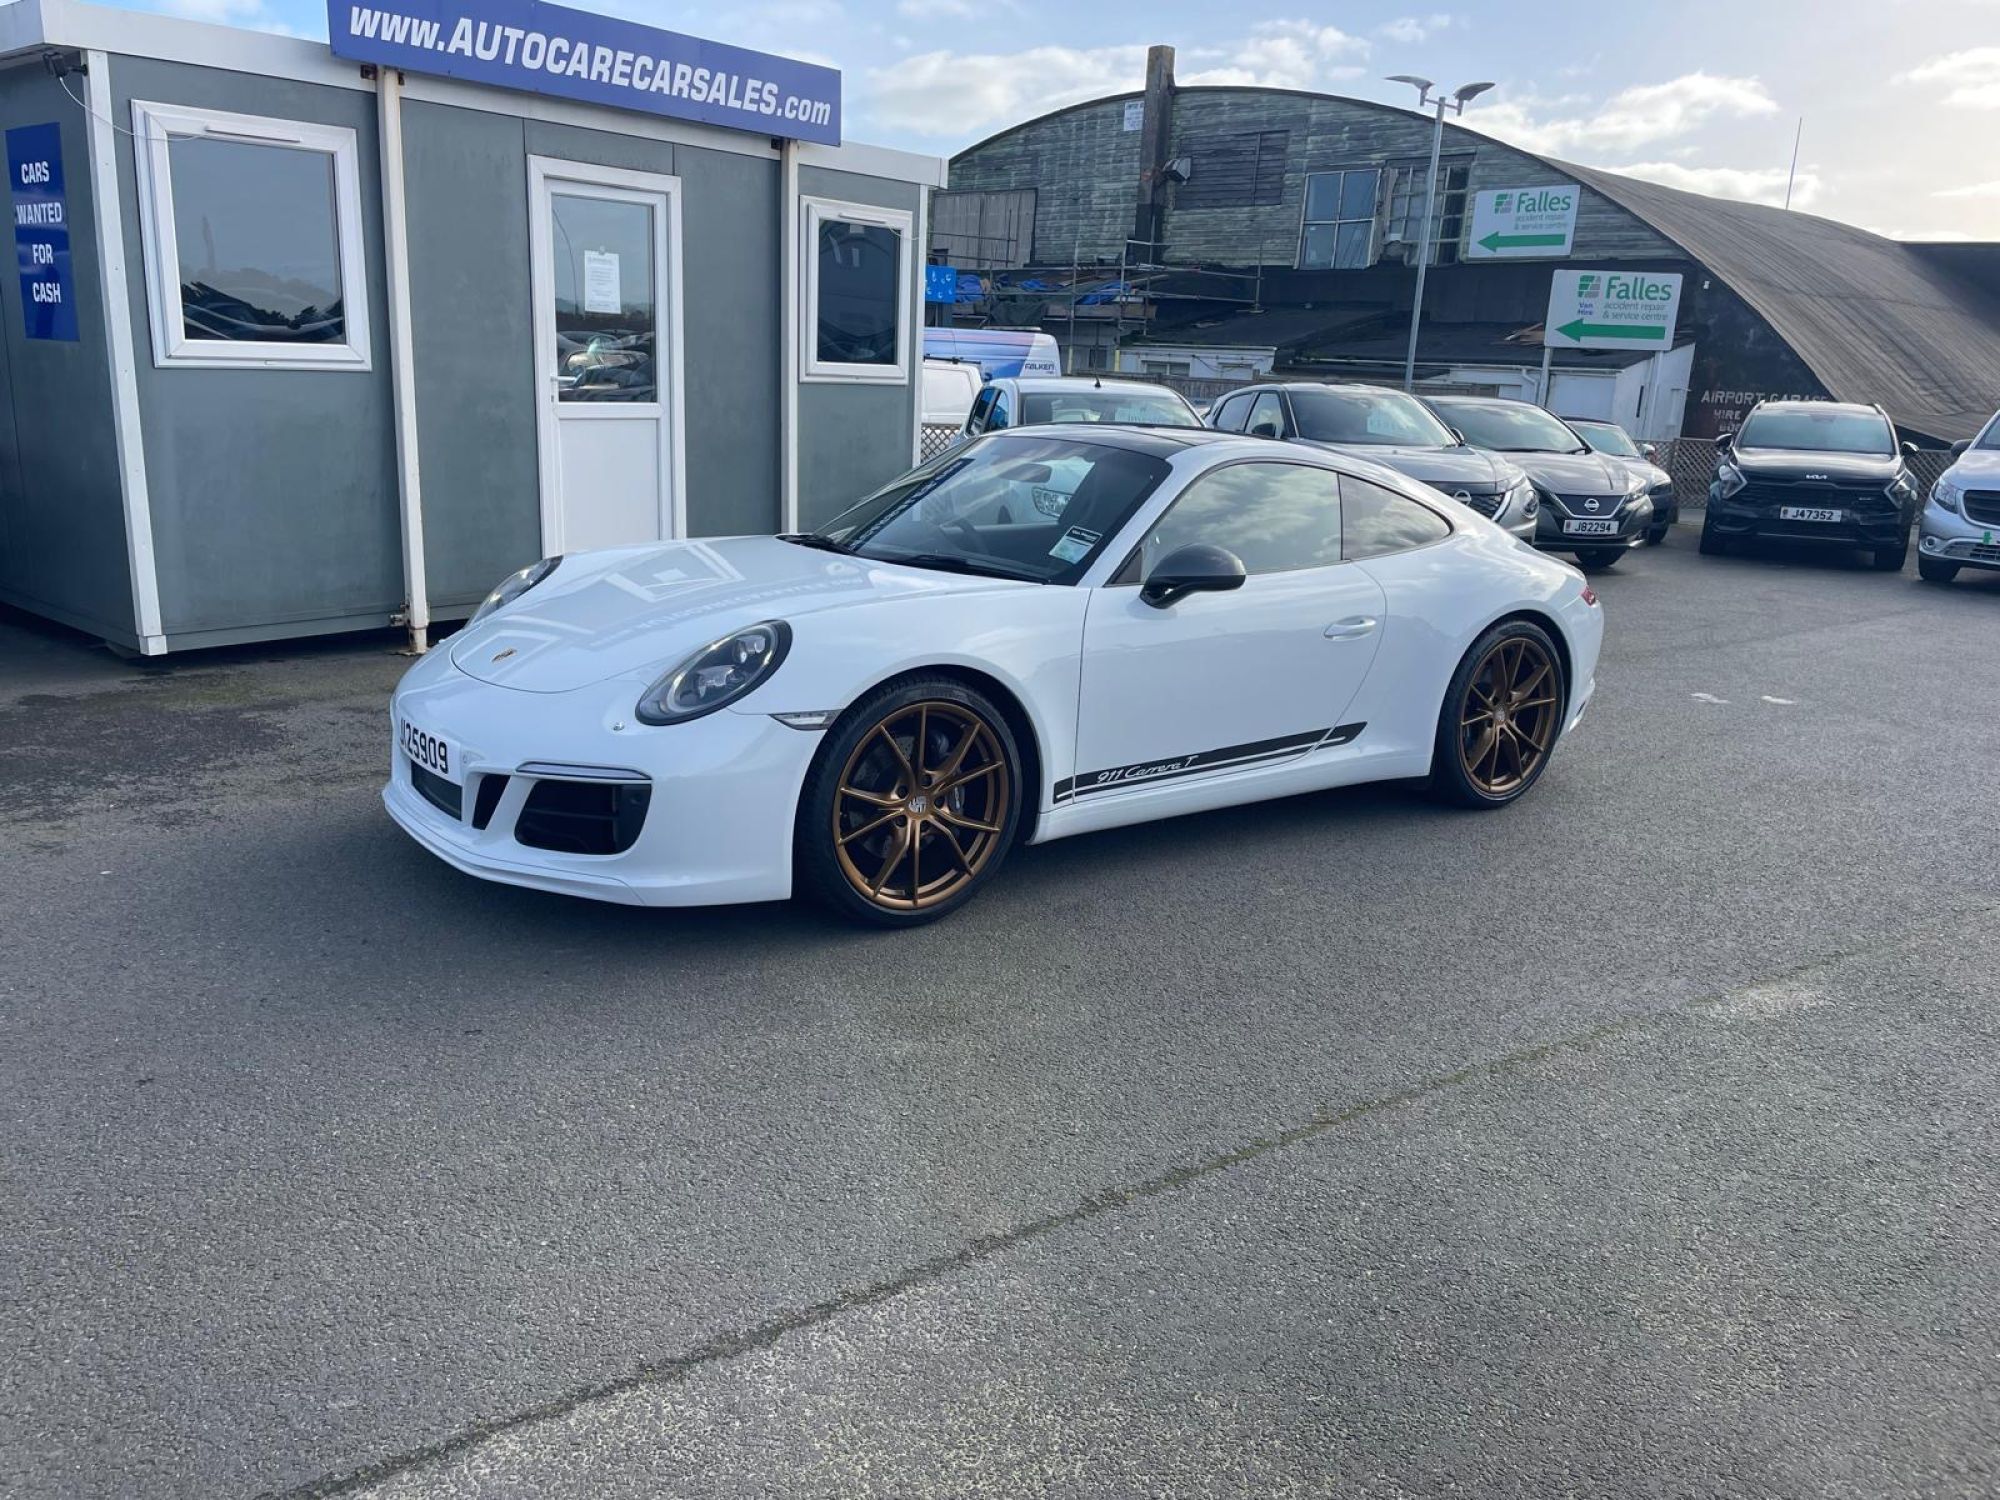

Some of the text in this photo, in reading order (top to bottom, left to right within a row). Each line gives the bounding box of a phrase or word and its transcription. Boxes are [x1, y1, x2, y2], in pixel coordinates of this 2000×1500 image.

[21, 161, 49, 184] CARS
[1517, 191, 1571, 213] Falles
[16, 202, 62, 224] WANTED
[32, 244, 53, 264] FOR
[33, 283, 61, 303] CASH
[1606, 276, 1672, 300] Falles
[1604, 301, 1639, 311] accident
[1611, 311, 1639, 320] service
[1701, 390, 1765, 405] AIRPORT
[1714, 409, 1741, 420] HIRE
[1792, 509, 1834, 520] J47352
[1575, 522, 1611, 532] J82294
[1097, 755, 1199, 784] 911 Carrera T
